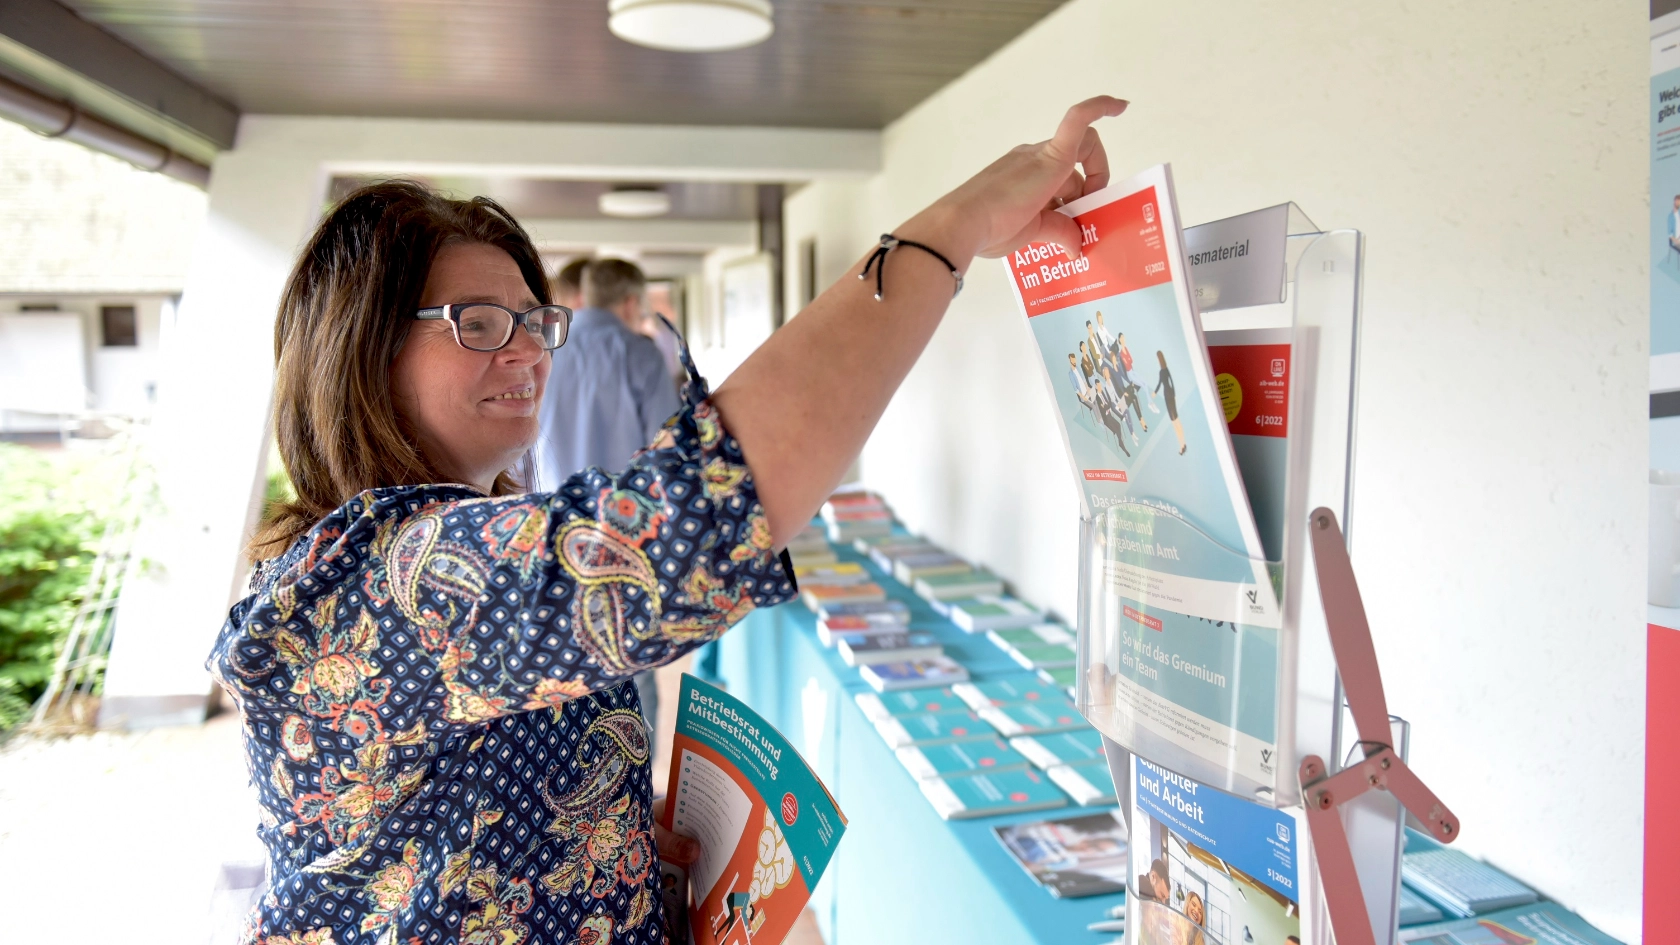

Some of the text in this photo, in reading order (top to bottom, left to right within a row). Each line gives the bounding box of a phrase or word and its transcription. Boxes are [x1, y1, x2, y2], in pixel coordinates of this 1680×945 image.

[1658, 105, 1676, 123] gibt
[1188, 239, 1249, 266] nsmaterial
[1019, 254, 1090, 290] im Betrieb
[1255, 414, 1283, 427] 6|2022
[1091, 493, 1109, 508] Das
[1135, 519, 1153, 536] und
[1140, 539, 1155, 557] im
[1156, 542, 1180, 561] Amt
[1122, 630, 1226, 688] So wird das Gremium
[1122, 645, 1158, 680] ein Team
[691, 688, 781, 761] Betriebsrat und
[689, 702, 779, 781] Mitbestimmung
[720, 736, 729, 745] FÜR
[1139, 772, 1205, 825] und Arbeit
[1187, 825, 1217, 846] DATENSCHUTZ
[1267, 867, 1293, 889] 5|2022
